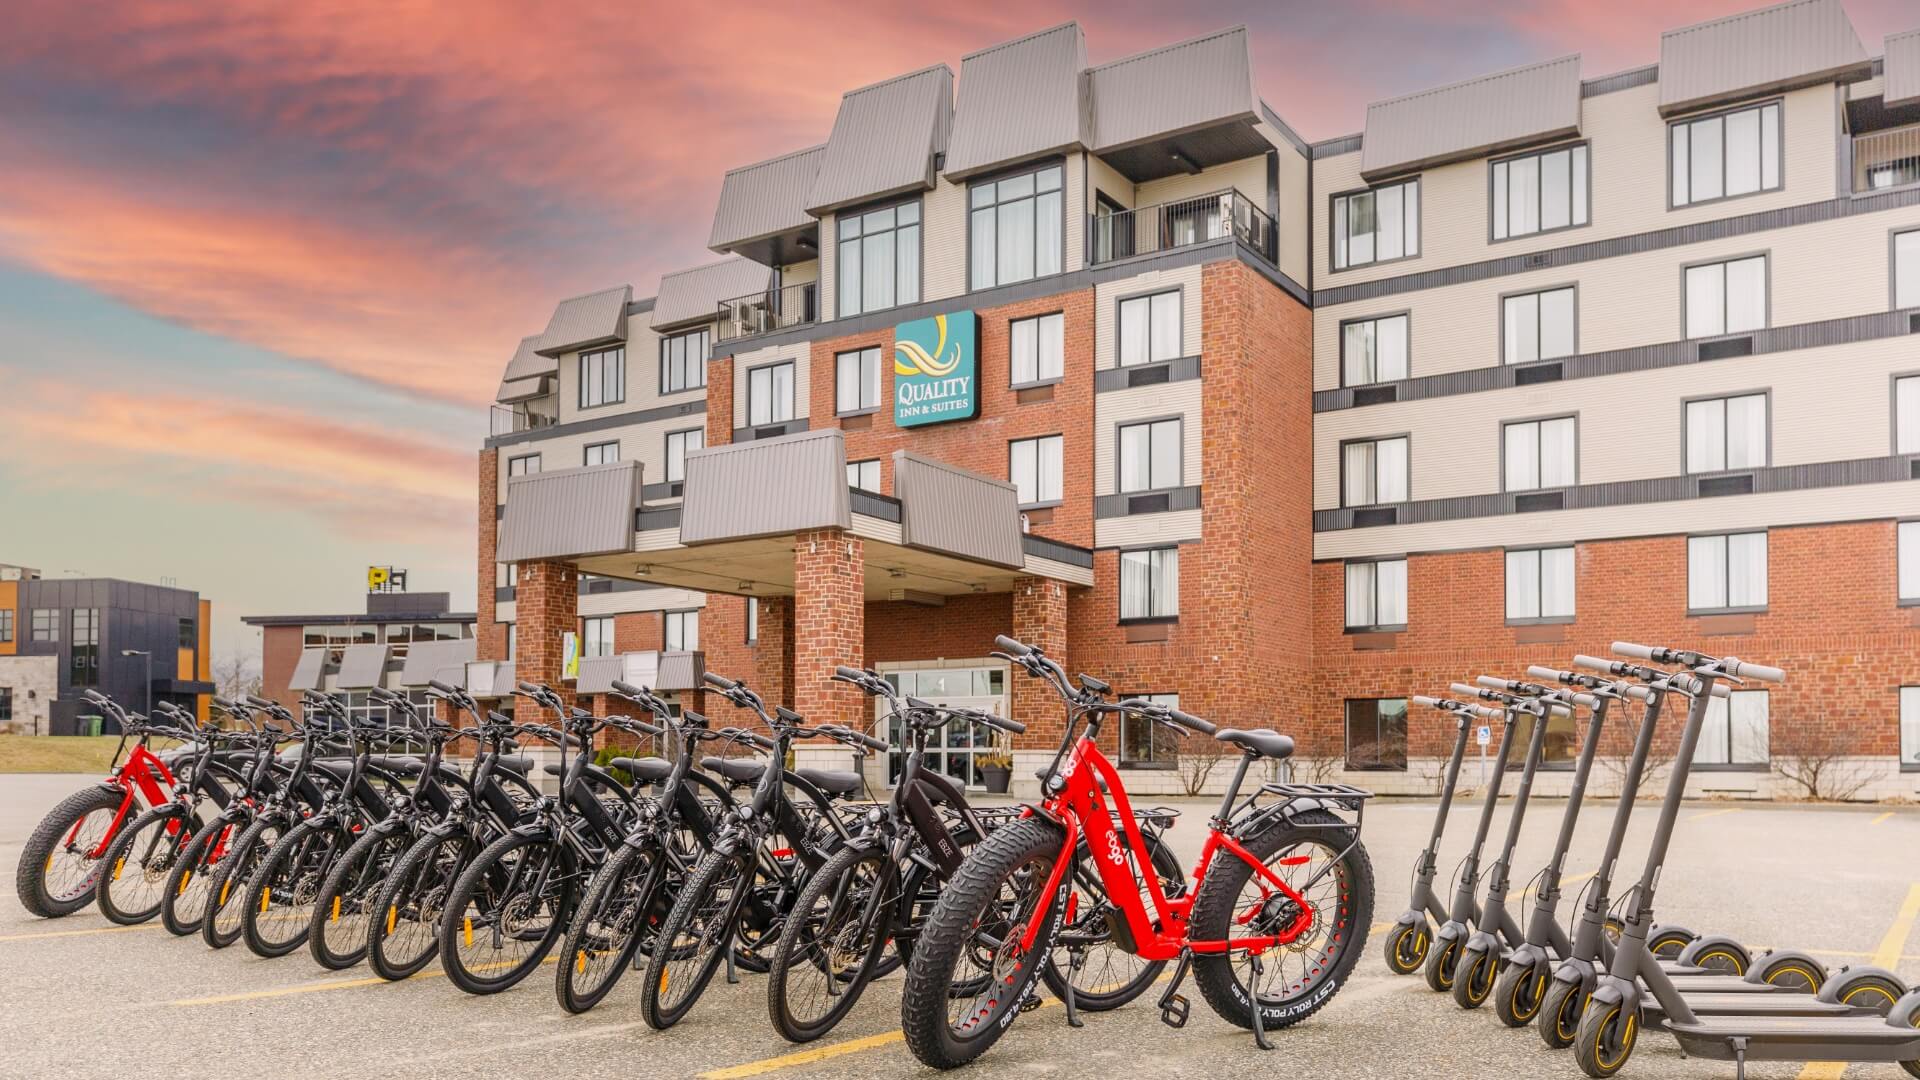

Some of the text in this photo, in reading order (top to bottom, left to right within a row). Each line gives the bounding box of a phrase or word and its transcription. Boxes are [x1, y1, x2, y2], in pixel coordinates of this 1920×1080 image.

[898, 376, 970, 406] QUALITY
[899, 398, 968, 418] INN & SUITES
[1105, 829, 1124, 866] ebgo
[1057, 883, 1067, 912] CST
[1048, 914, 1063, 946] ROLY
[1034, 946, 1052, 980] POLY
[1313, 979, 1336, 1005] CST
[1262, 1008, 1287, 1018] POLY
[1287, 999, 1312, 1017] ROLY
